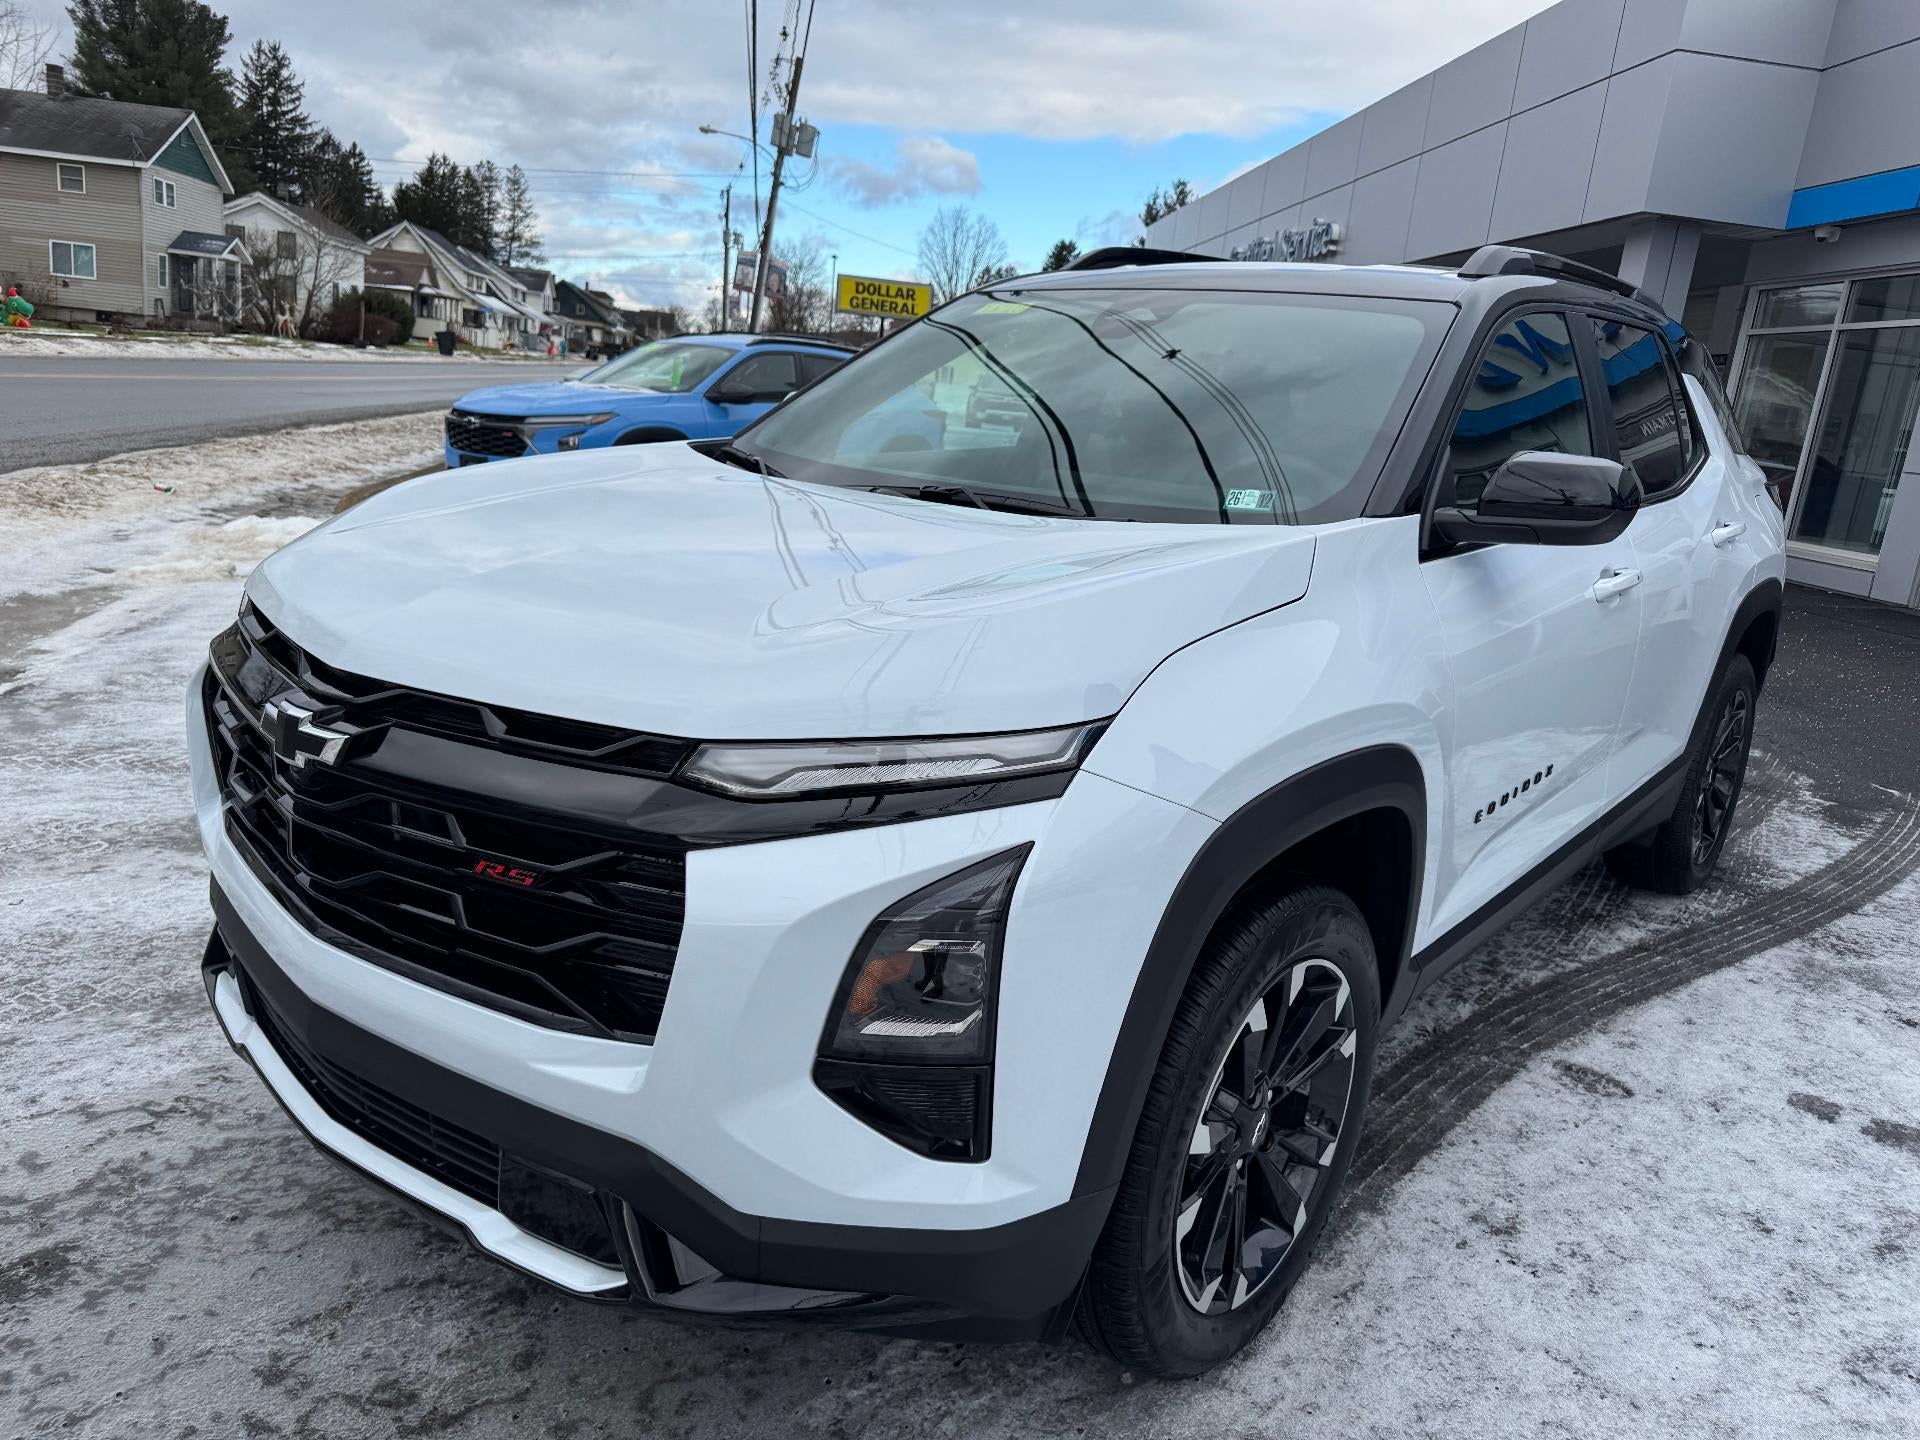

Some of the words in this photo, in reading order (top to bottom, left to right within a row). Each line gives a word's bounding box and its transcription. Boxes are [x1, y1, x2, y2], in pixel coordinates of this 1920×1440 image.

[1281, 216, 1340, 262] Service
[855, 281, 916, 302] DOLLAR
[849, 296, 919, 316] GENERAL
[1227, 491, 1242, 506] 26
[1474, 763, 1554, 824] EQUINOX
[475, 860, 538, 888] RS
